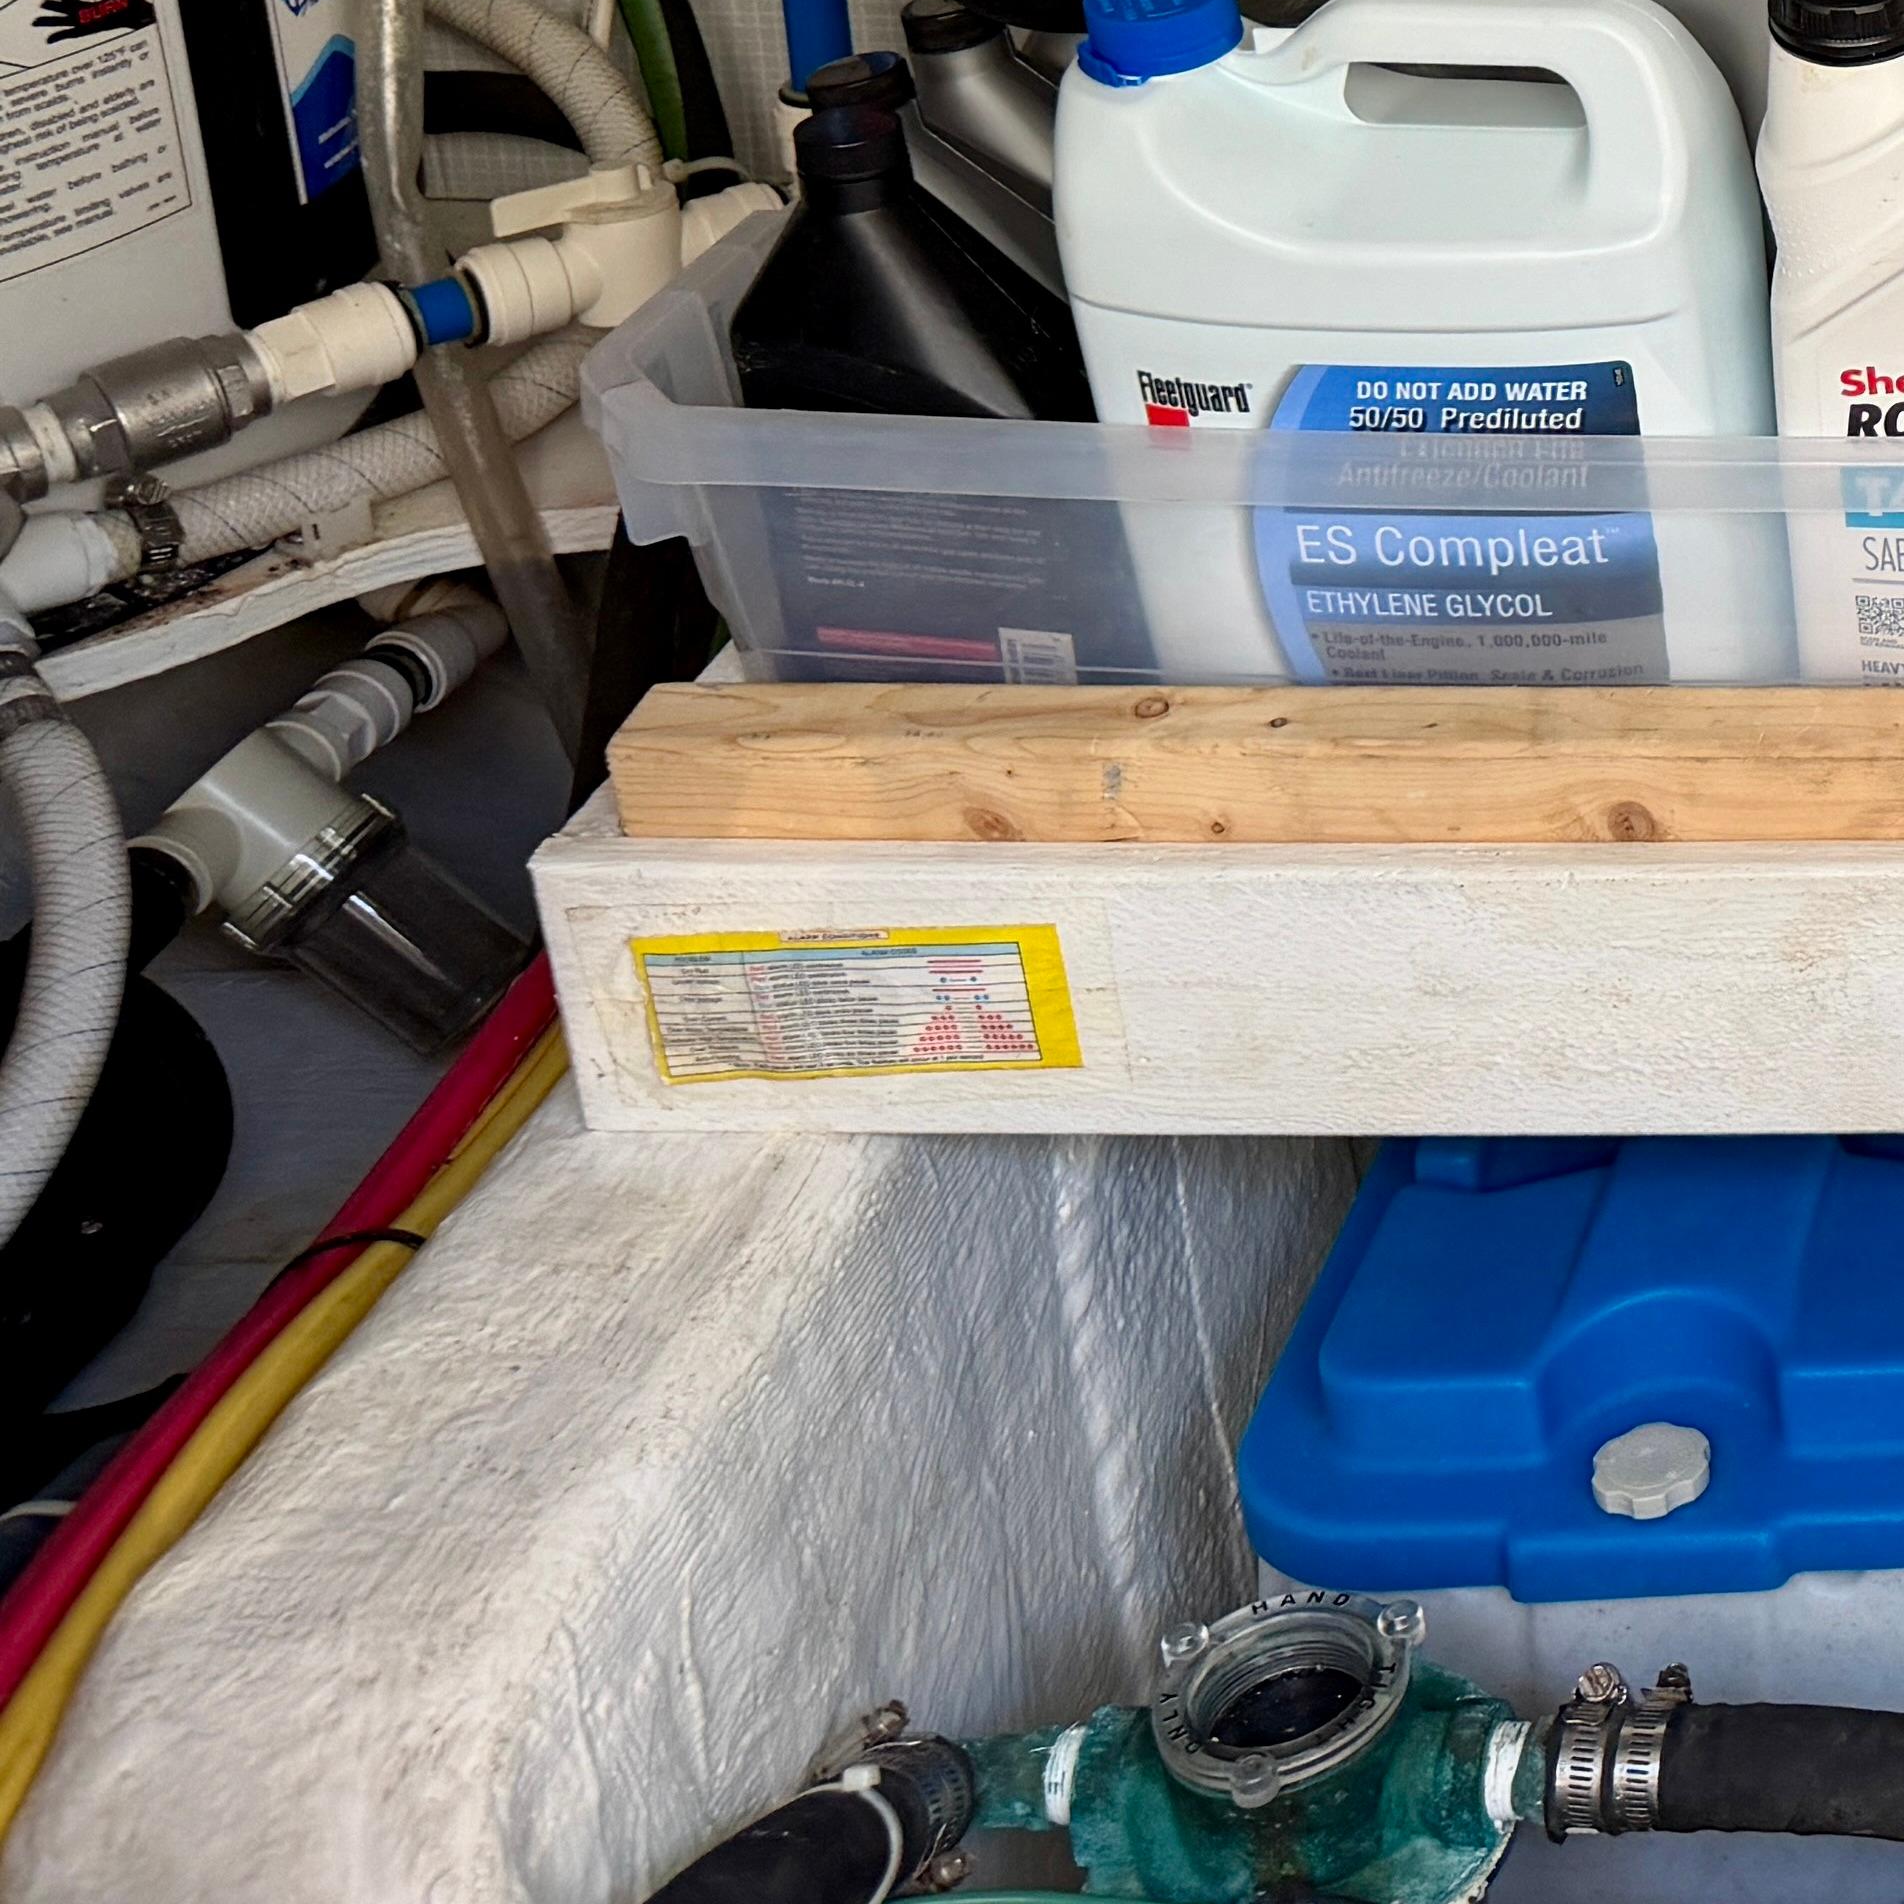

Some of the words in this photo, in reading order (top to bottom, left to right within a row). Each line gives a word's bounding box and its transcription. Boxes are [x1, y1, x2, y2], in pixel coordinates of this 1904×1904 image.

[1137, 370, 1253, 418] Fleetguard
[1356, 381, 1388, 401] DO
[1396, 381, 1442, 401] NOT
[1447, 381, 1498, 401] ADD
[1504, 381, 1588, 402] WATER
[1349, 406, 1424, 430] 50/50
[1440, 407, 1583, 430] Prediluted
[1297, 525, 1357, 566] ES
[1375, 526, 1608, 575] Compleat
[1306, 590, 1438, 617] ETHYLENE
[1447, 594, 1553, 618] GLYCOL
[1251, 1591, 1350, 1614] HAND
